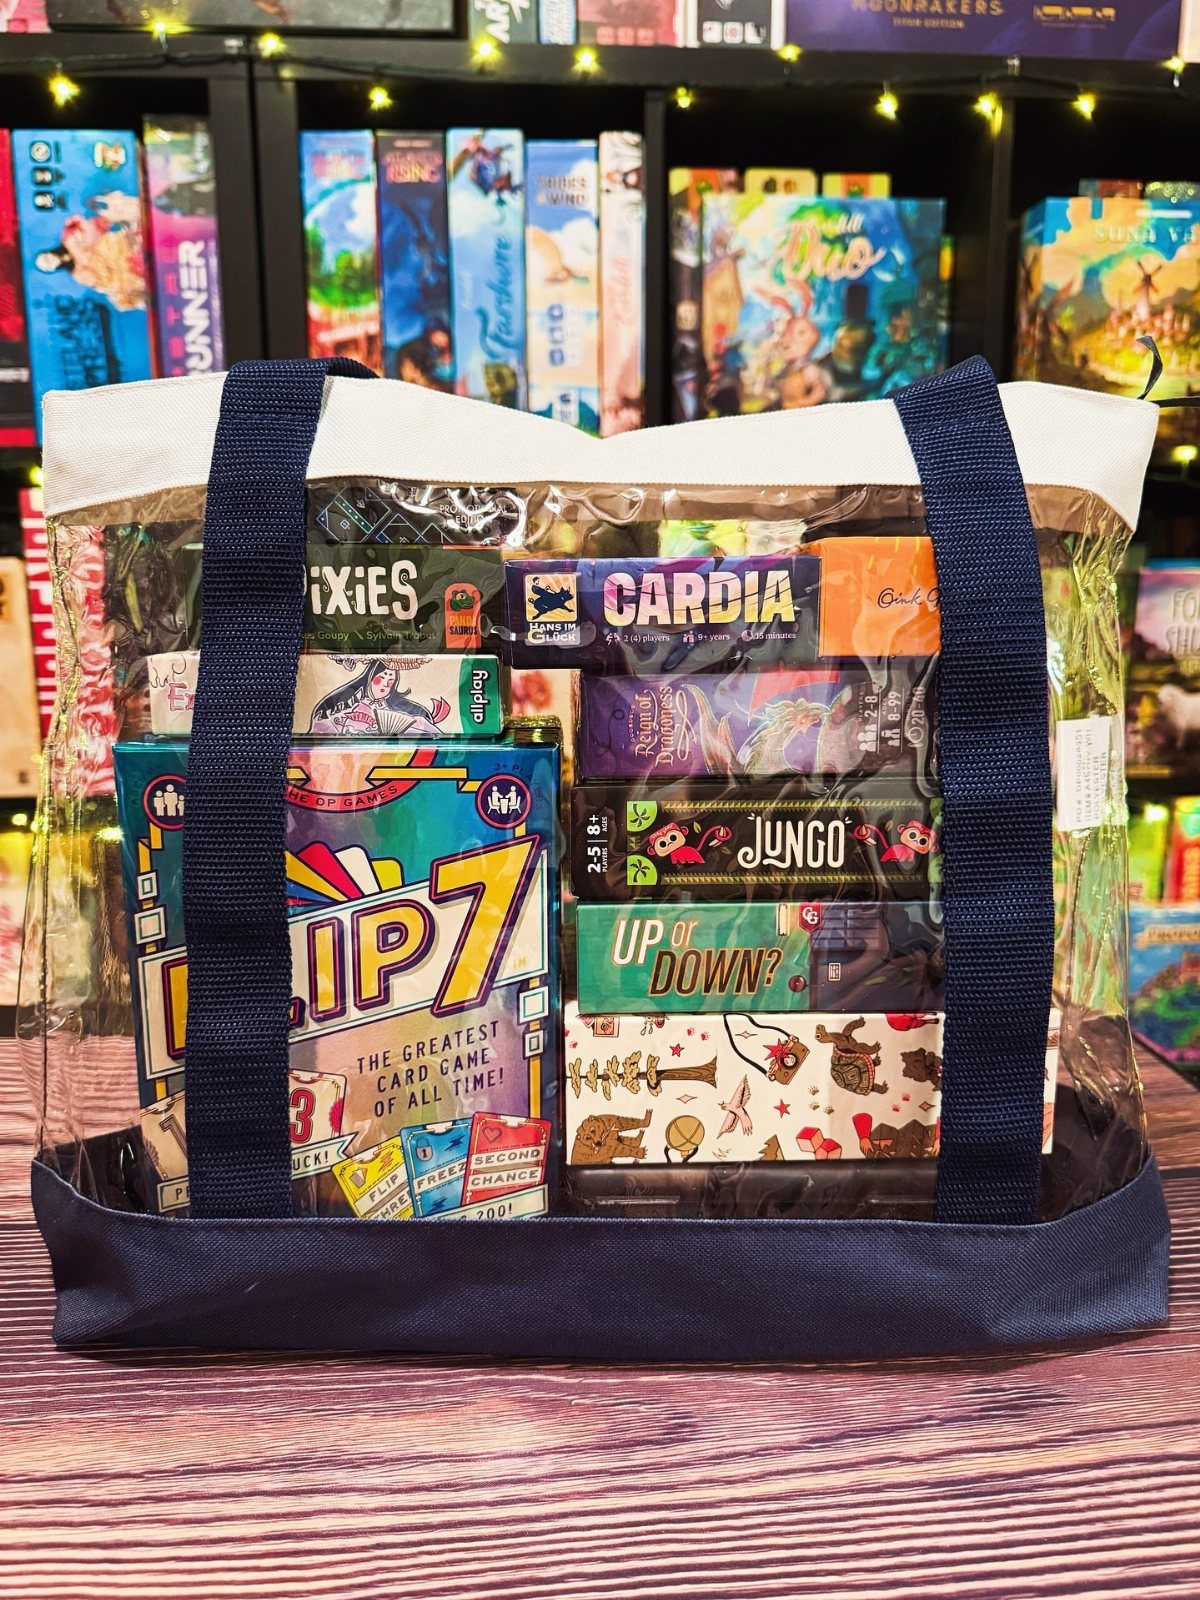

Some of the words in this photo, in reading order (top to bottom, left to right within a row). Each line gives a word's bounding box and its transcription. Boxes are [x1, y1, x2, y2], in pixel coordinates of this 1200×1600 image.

[604, 571, 796, 627] CARDIA
[878, 587, 922, 609] Oink
[317, 631, 350, 642] Goupy
[450, 626, 478, 636] SAURUS
[527, 628, 577, 644] GLÜCK
[529, 622, 562, 632] HANS
[564, 622, 577, 632] IM
[631, 635, 641, 644] (4)
[643, 634, 671, 643] players
[709, 633, 731, 642] years
[471, 669, 489, 724] allplay
[633, 689, 656, 711] of
[864, 695, 878, 718] 2-8
[887, 691, 902, 721] 8-99
[634, 712, 659, 758] Reign
[287, 785, 309, 804] HE
[316, 797, 337, 807] OP
[344, 786, 398, 807] GAMES
[587, 813, 601, 837] 8+
[737, 819, 845, 869] JUNGO
[587, 845, 601, 874] 2-5
[429, 834, 540, 1019] 7
[611, 918, 664, 966] UP
[670, 918, 698, 947] or
[649, 947, 784, 997] DOWN?
[357, 1050, 391, 1074] THE
[403, 1020, 499, 1062] GREATEST
[377, 1064, 429, 1093] CARD
[440, 1047, 490, 1076] GAME
[374, 1096, 397, 1117] OF
[408, 1085, 442, 1109] ALL
[453, 1067, 504, 1096] TIME!
[290, 1151, 329, 1171] UCK!
[474, 1149, 541, 1165] SECOND
[369, 1173, 398, 1203] FLIP
[416, 1161, 466, 1190] FREEZ
[471, 1169, 539, 1187] CHANCE
